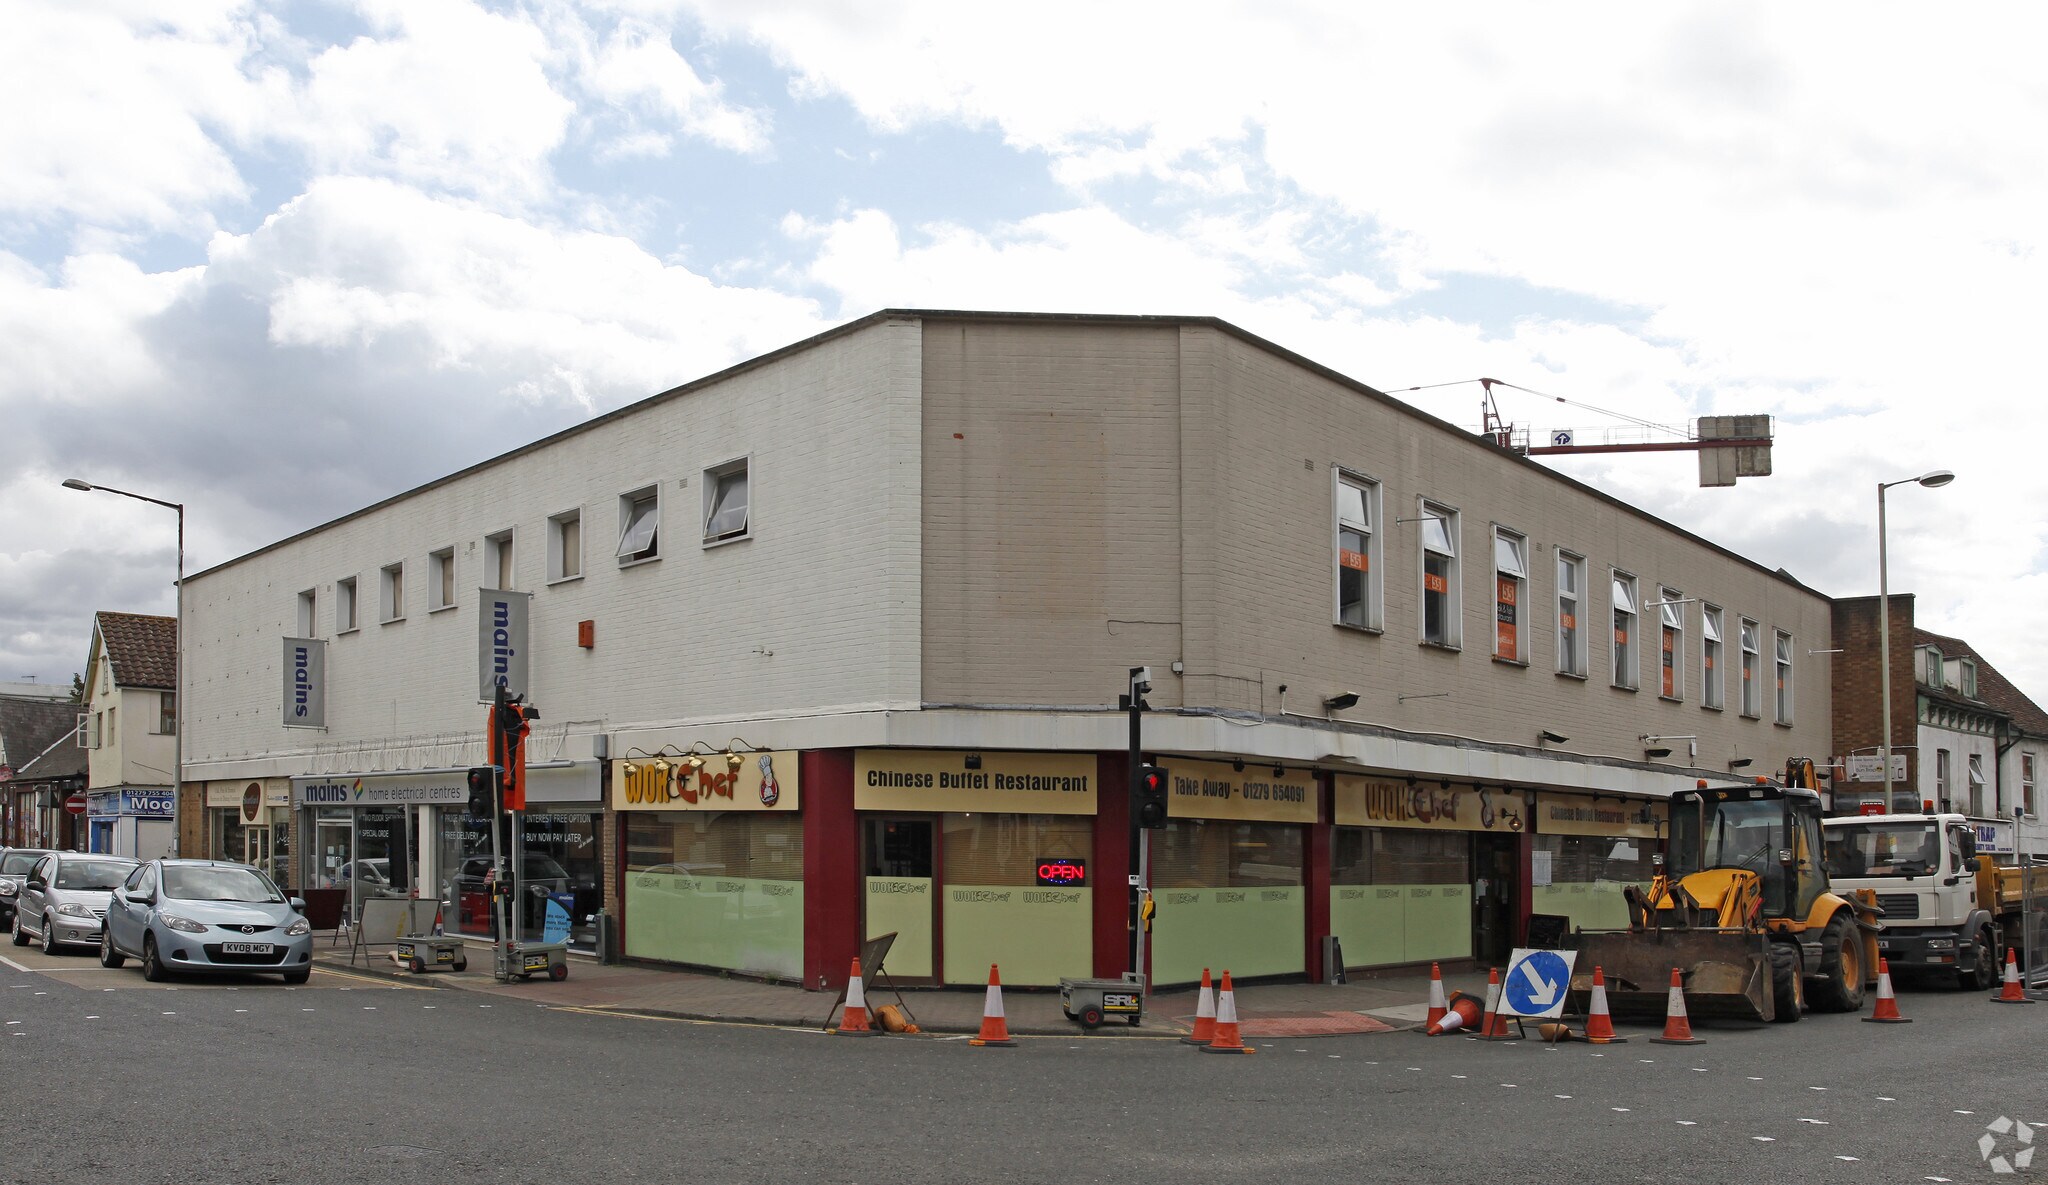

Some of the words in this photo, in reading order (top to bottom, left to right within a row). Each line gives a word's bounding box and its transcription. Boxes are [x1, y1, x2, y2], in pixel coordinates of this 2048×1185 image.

[494, 602, 514, 687] mains
[296, 648, 312, 717] mains
[676, 763, 740, 804] Chef
[868, 770, 933, 788] Chinese
[940, 772, 988, 789] Buffet
[995, 773, 1087, 791] Restaurant
[1174, 776, 1198, 796] Take
[1202, 779, 1230, 799] Away
[1243, 782, 1269, 800] 01279
[1273, 785, 1305, 802] 654091
[306, 779, 347, 801] mains
[369, 787, 388, 800] home
[392, 785, 426, 799] electrical
[430, 786, 460, 799] centres
[131, 797, 173, 810] Moo
[527, 814, 552, 823] INTEREST
[554, 814, 567, 822] FREE
[569, 814, 591, 823] OPTION
[1551, 806, 1574, 820] Chinese
[1595, 809, 1625, 824] Restaurant
[445, 831, 456, 840] FREE
[457, 831, 479, 840] DELIVERY
[526, 832, 537, 842] BUY
[538, 832, 551, 842] NOW
[553, 833, 563, 842] PAY
[564, 833, 581, 843] LATER
[1976, 826, 1996, 842] TRAP
[1038, 864, 1085, 879] OPEN
[226, 944, 251, 952] KV08
[253, 944, 270, 953] MGY
